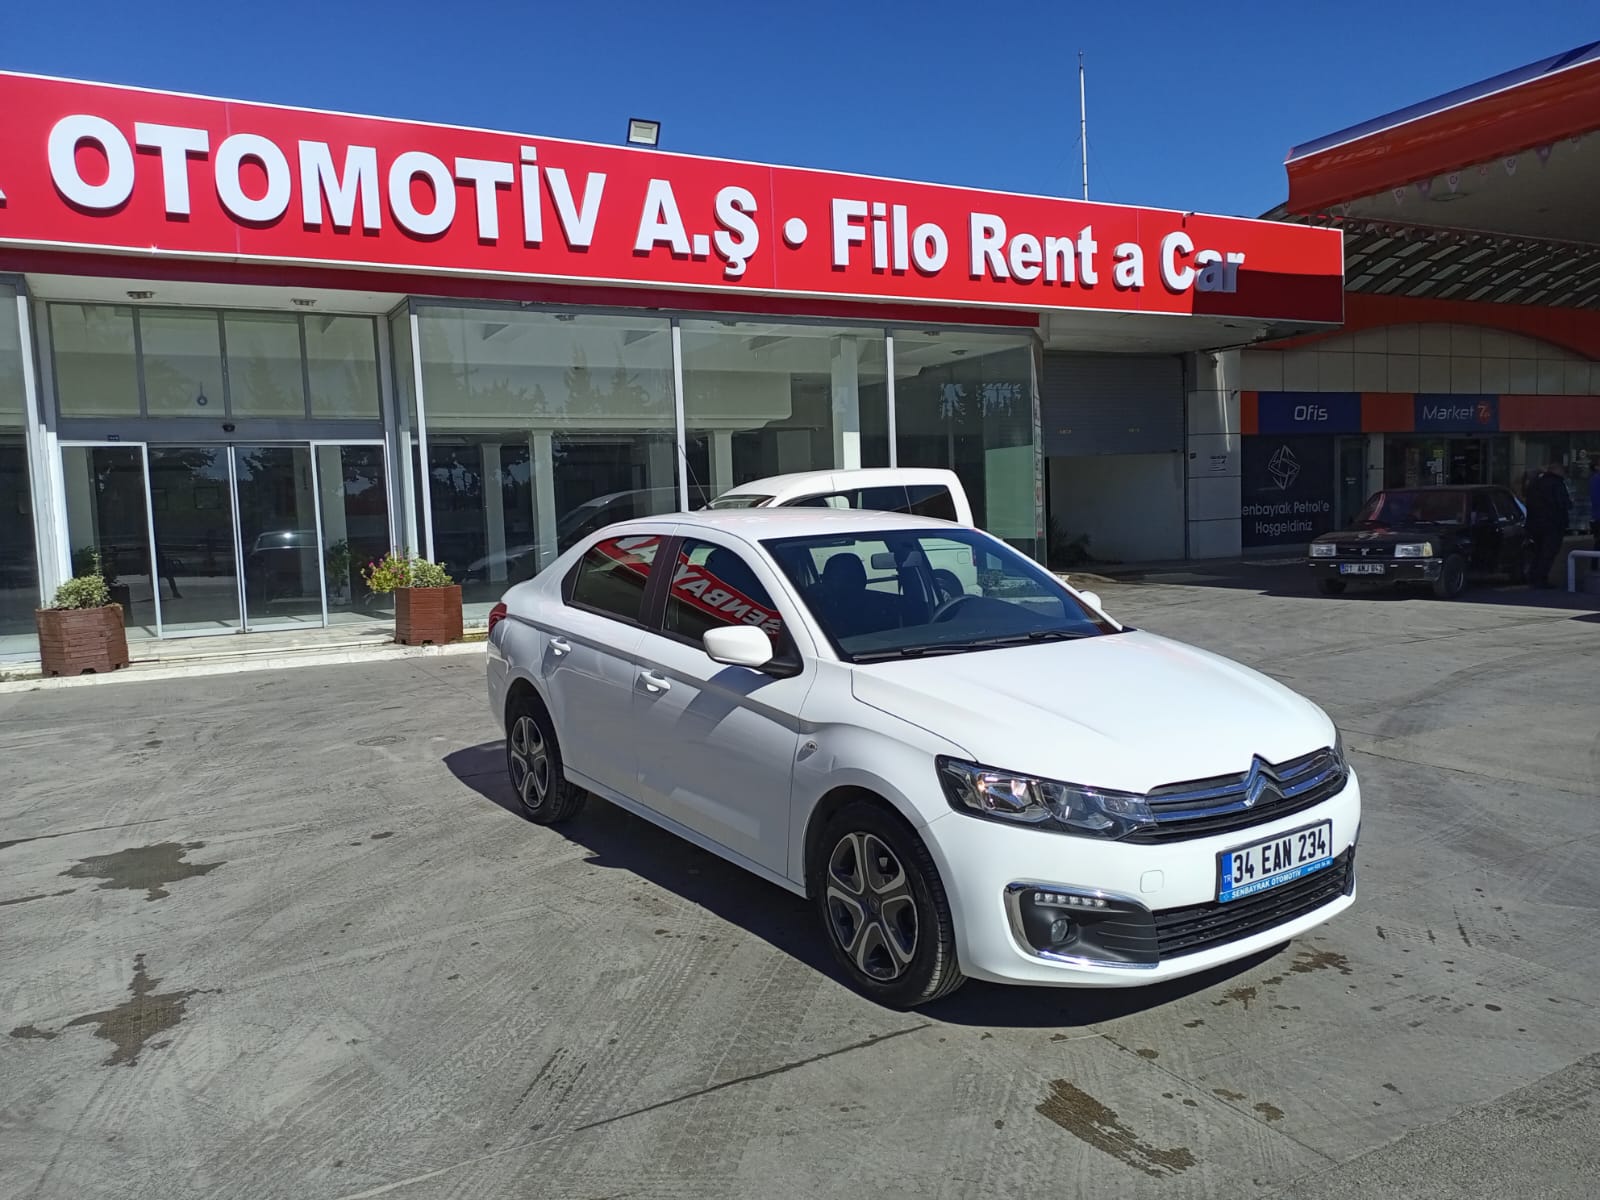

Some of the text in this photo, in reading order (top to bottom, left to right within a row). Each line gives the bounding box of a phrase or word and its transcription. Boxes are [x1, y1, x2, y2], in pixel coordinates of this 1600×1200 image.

[47, 114, 608, 247] OTOMOTİV
[832, 198, 949, 274] Filo
[970, 212, 1099, 286] Rent
[1113, 242, 1145, 288] a
[1159, 231, 1246, 293] Car
[1294, 404, 1328, 421] Ofis
[1423, 405, 1475, 420] Market
[1255, 520, 1313, 537] Hoşgeldiniz
[1234, 828, 1326, 884] 34 EAN 234
